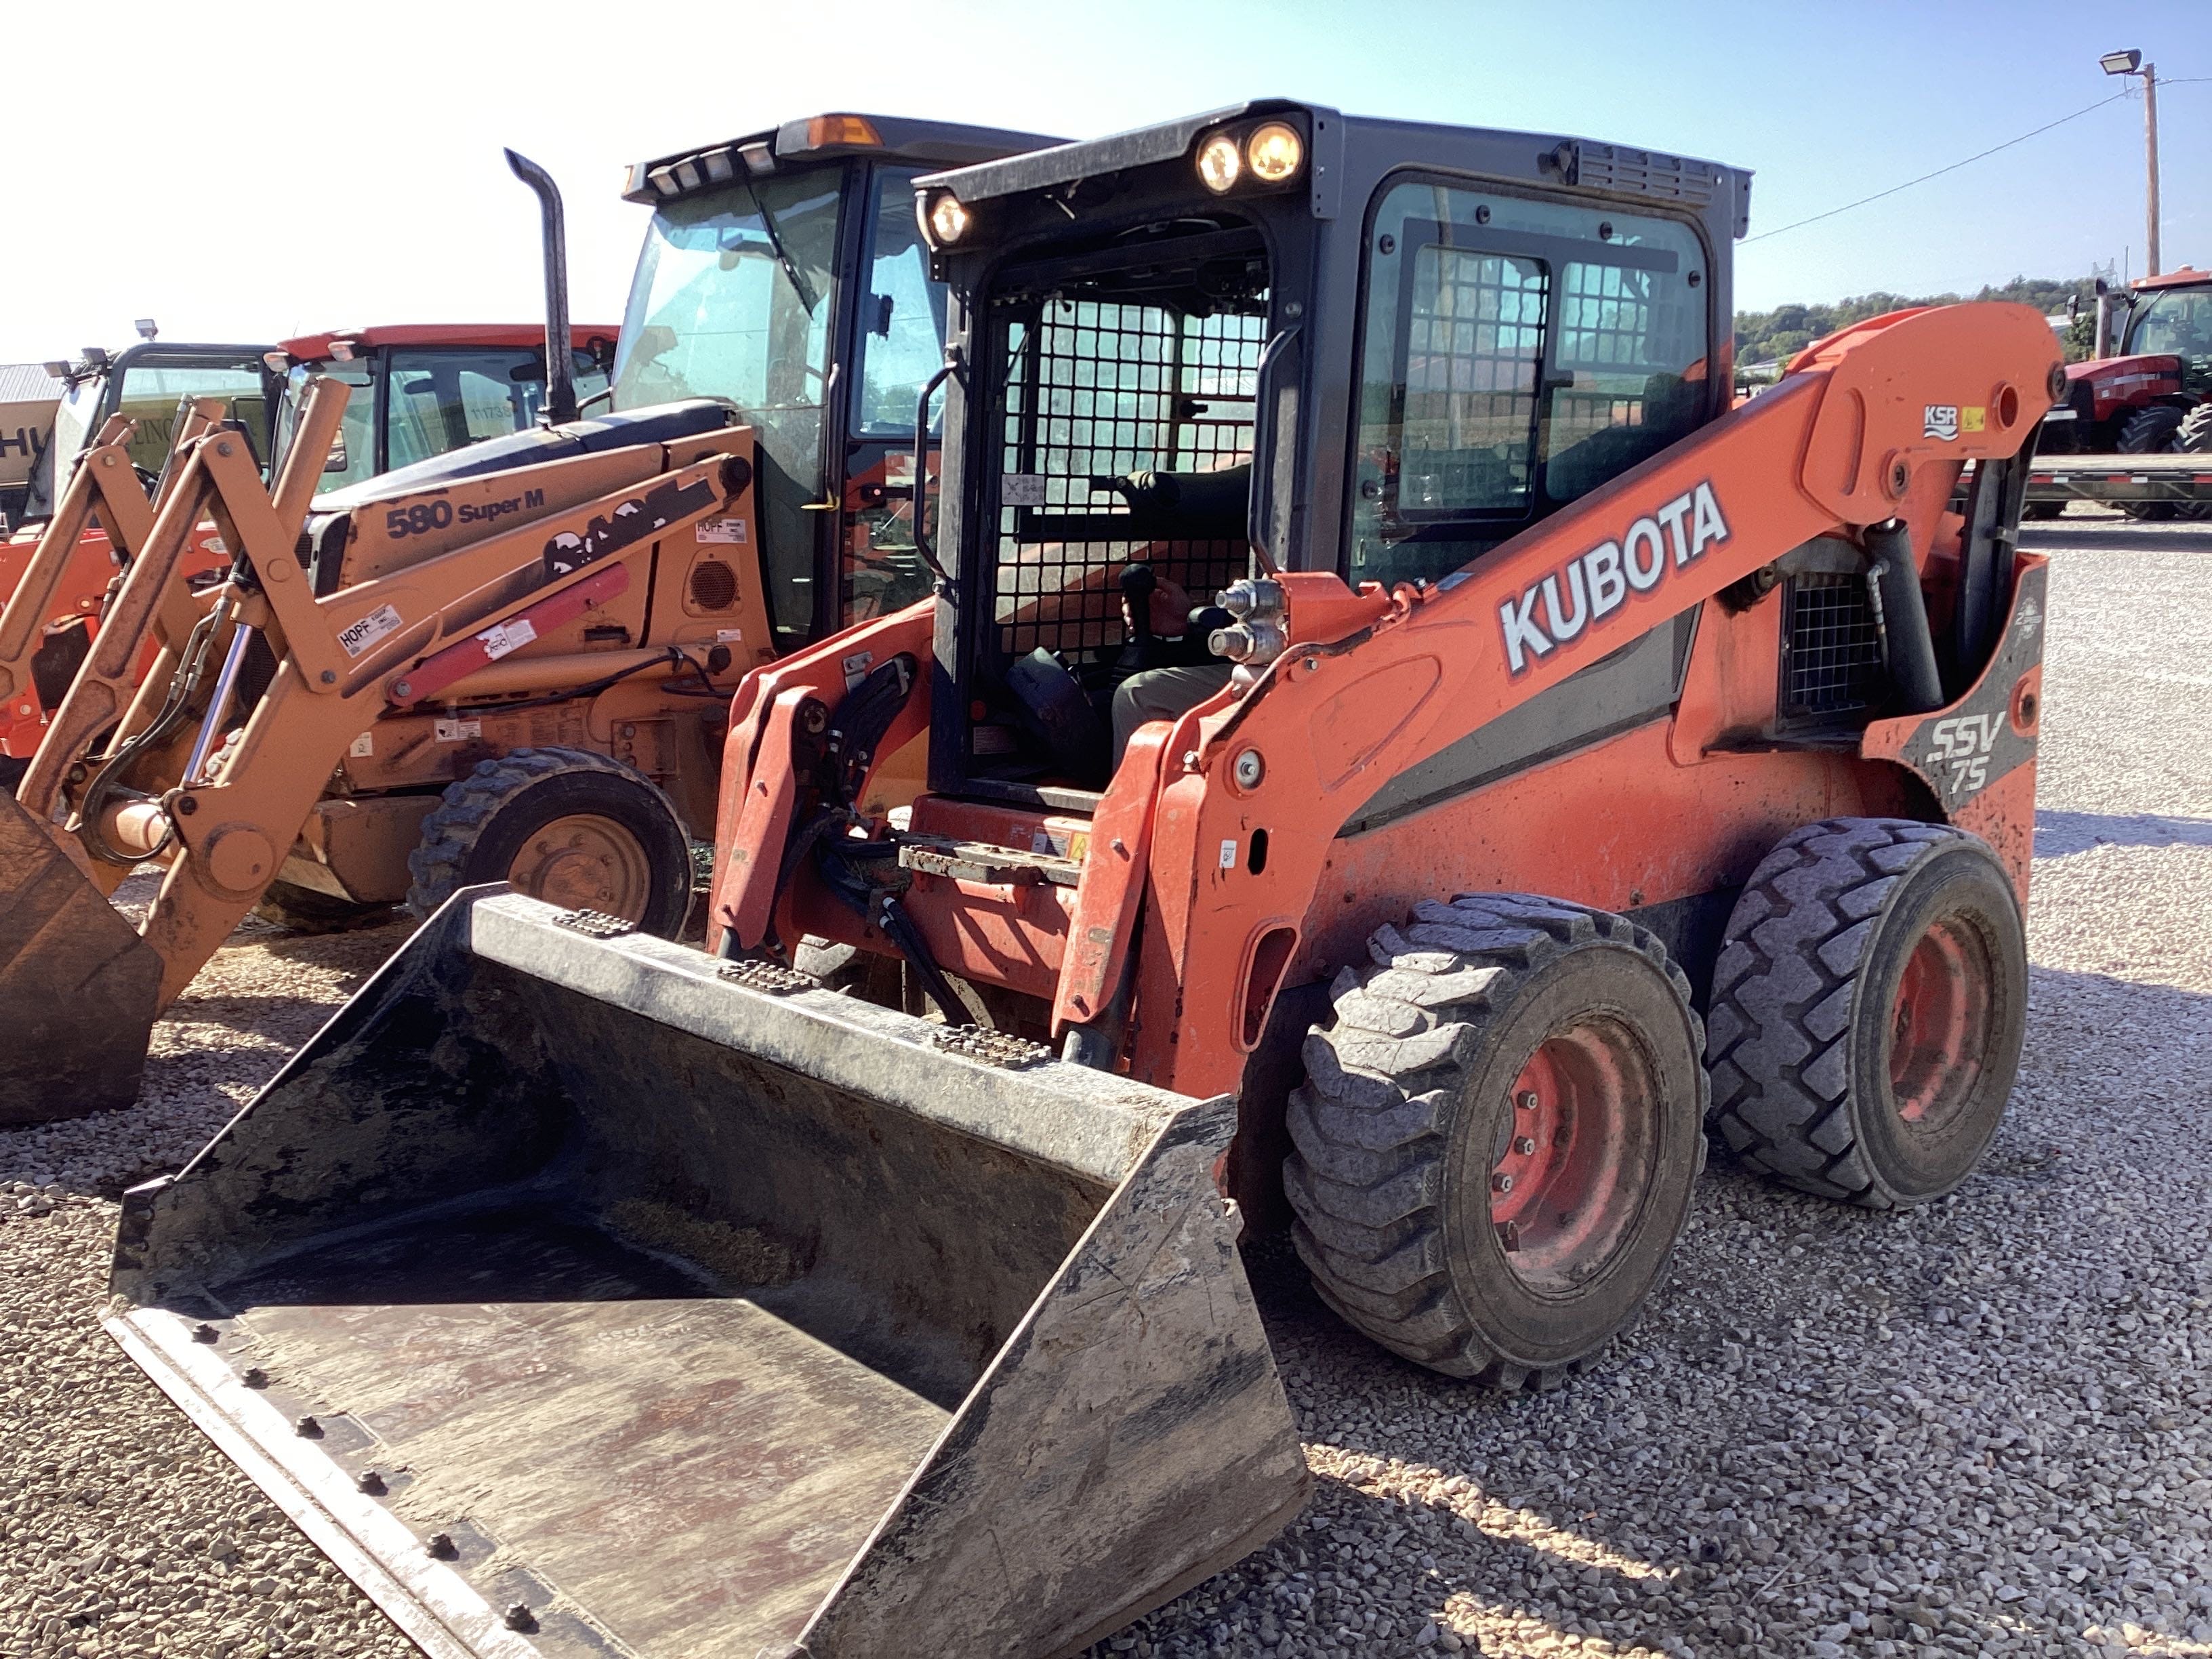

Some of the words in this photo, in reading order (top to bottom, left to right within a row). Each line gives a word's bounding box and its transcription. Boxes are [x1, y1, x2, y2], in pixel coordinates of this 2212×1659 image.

[1925, 405, 1957, 426] KSR
[386, 499, 453, 539] 580
[458, 497, 521, 523] Super
[525, 488, 545, 508] M
[1499, 480, 1729, 674] KUBOTA
[340, 620, 369, 648] HOPF
[1925, 710, 2007, 763] SSV
[1948, 756, 1990, 796] 75
